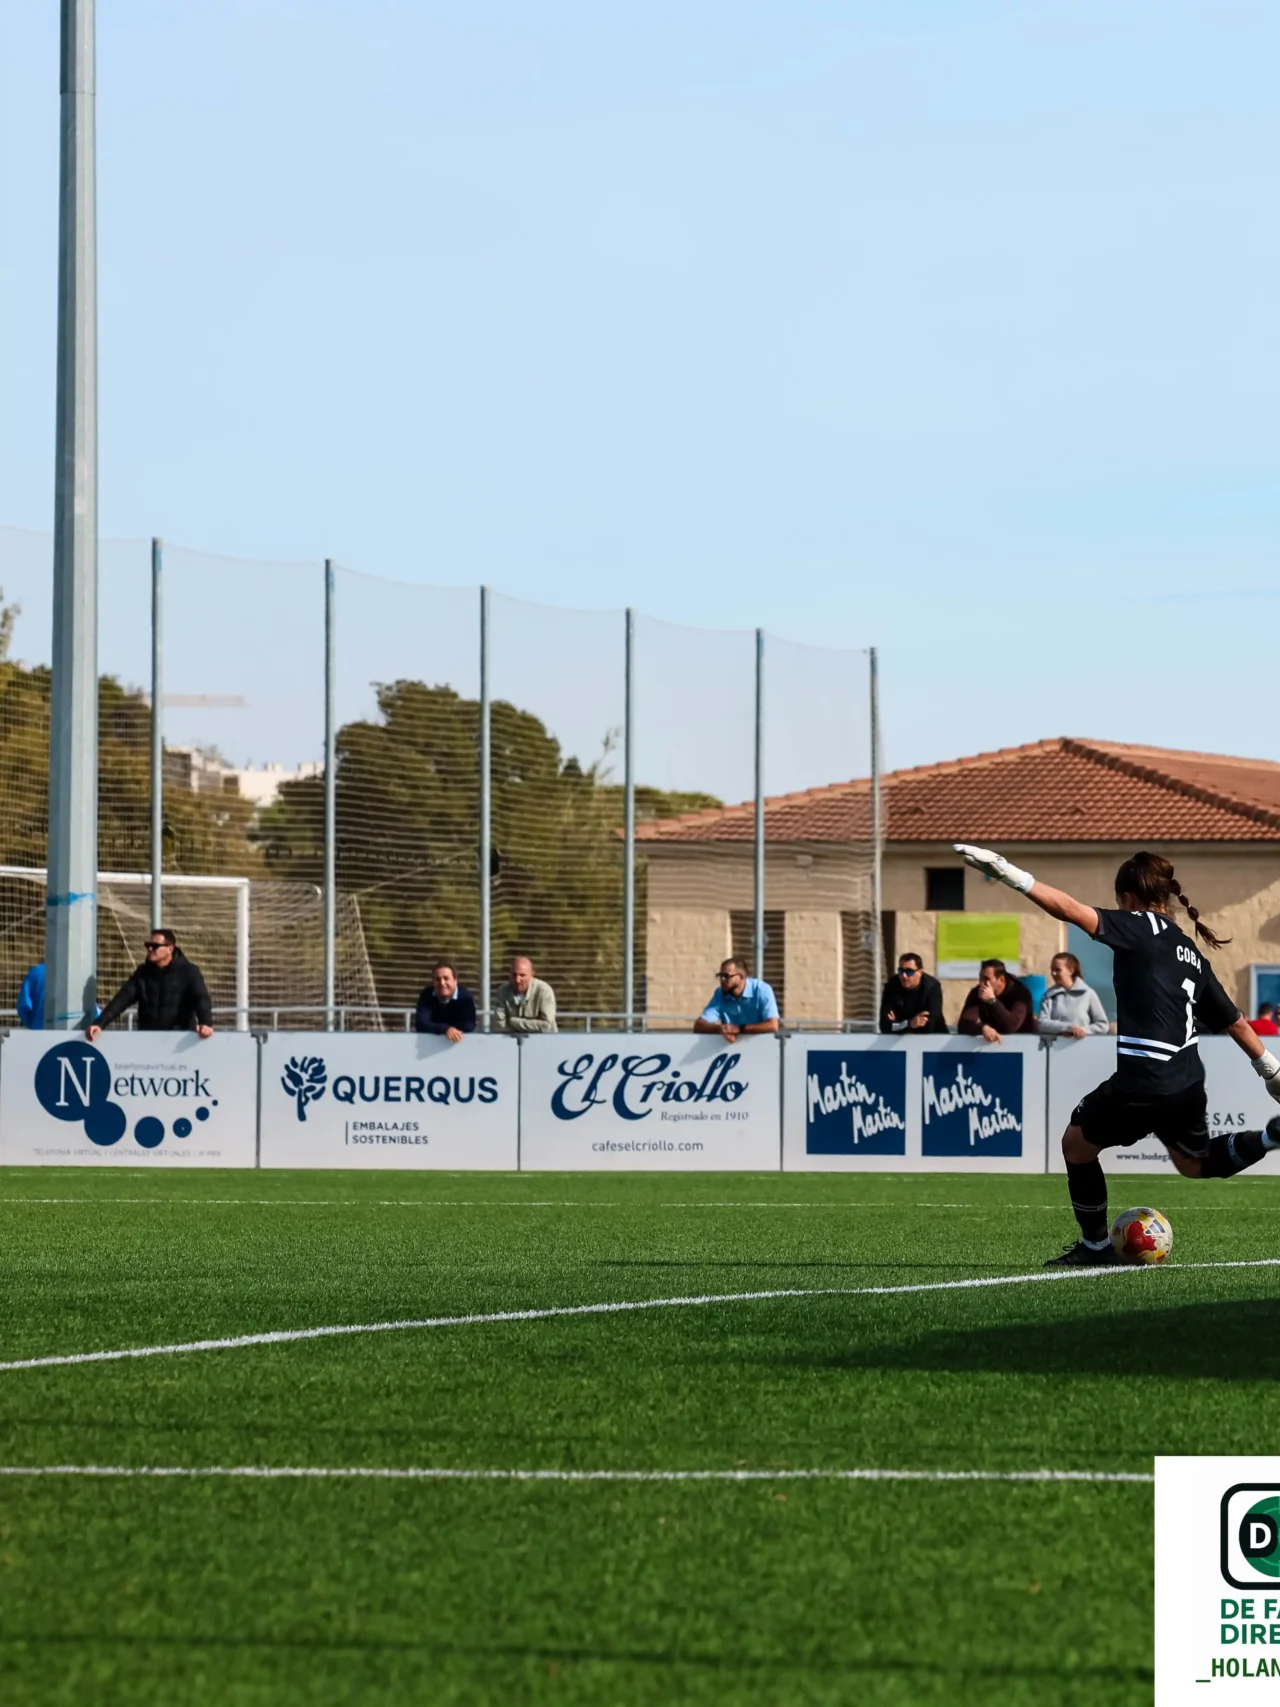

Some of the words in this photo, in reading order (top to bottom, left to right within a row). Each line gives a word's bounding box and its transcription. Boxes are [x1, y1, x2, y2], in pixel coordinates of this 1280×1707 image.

[332, 1075, 499, 1106] QUERQUS
[551, 1053, 619, 1121] El
[612, 1053, 749, 1121] Criollo
[660, 1111, 708, 1122] Registrado
[725, 1111, 749, 1121] 1910
[352, 1122, 419, 1131] EMBALAJES
[352, 1135, 429, 1145] SOSTENIBLES
[592, 1140, 704, 1151] cafeselcriollo.com
